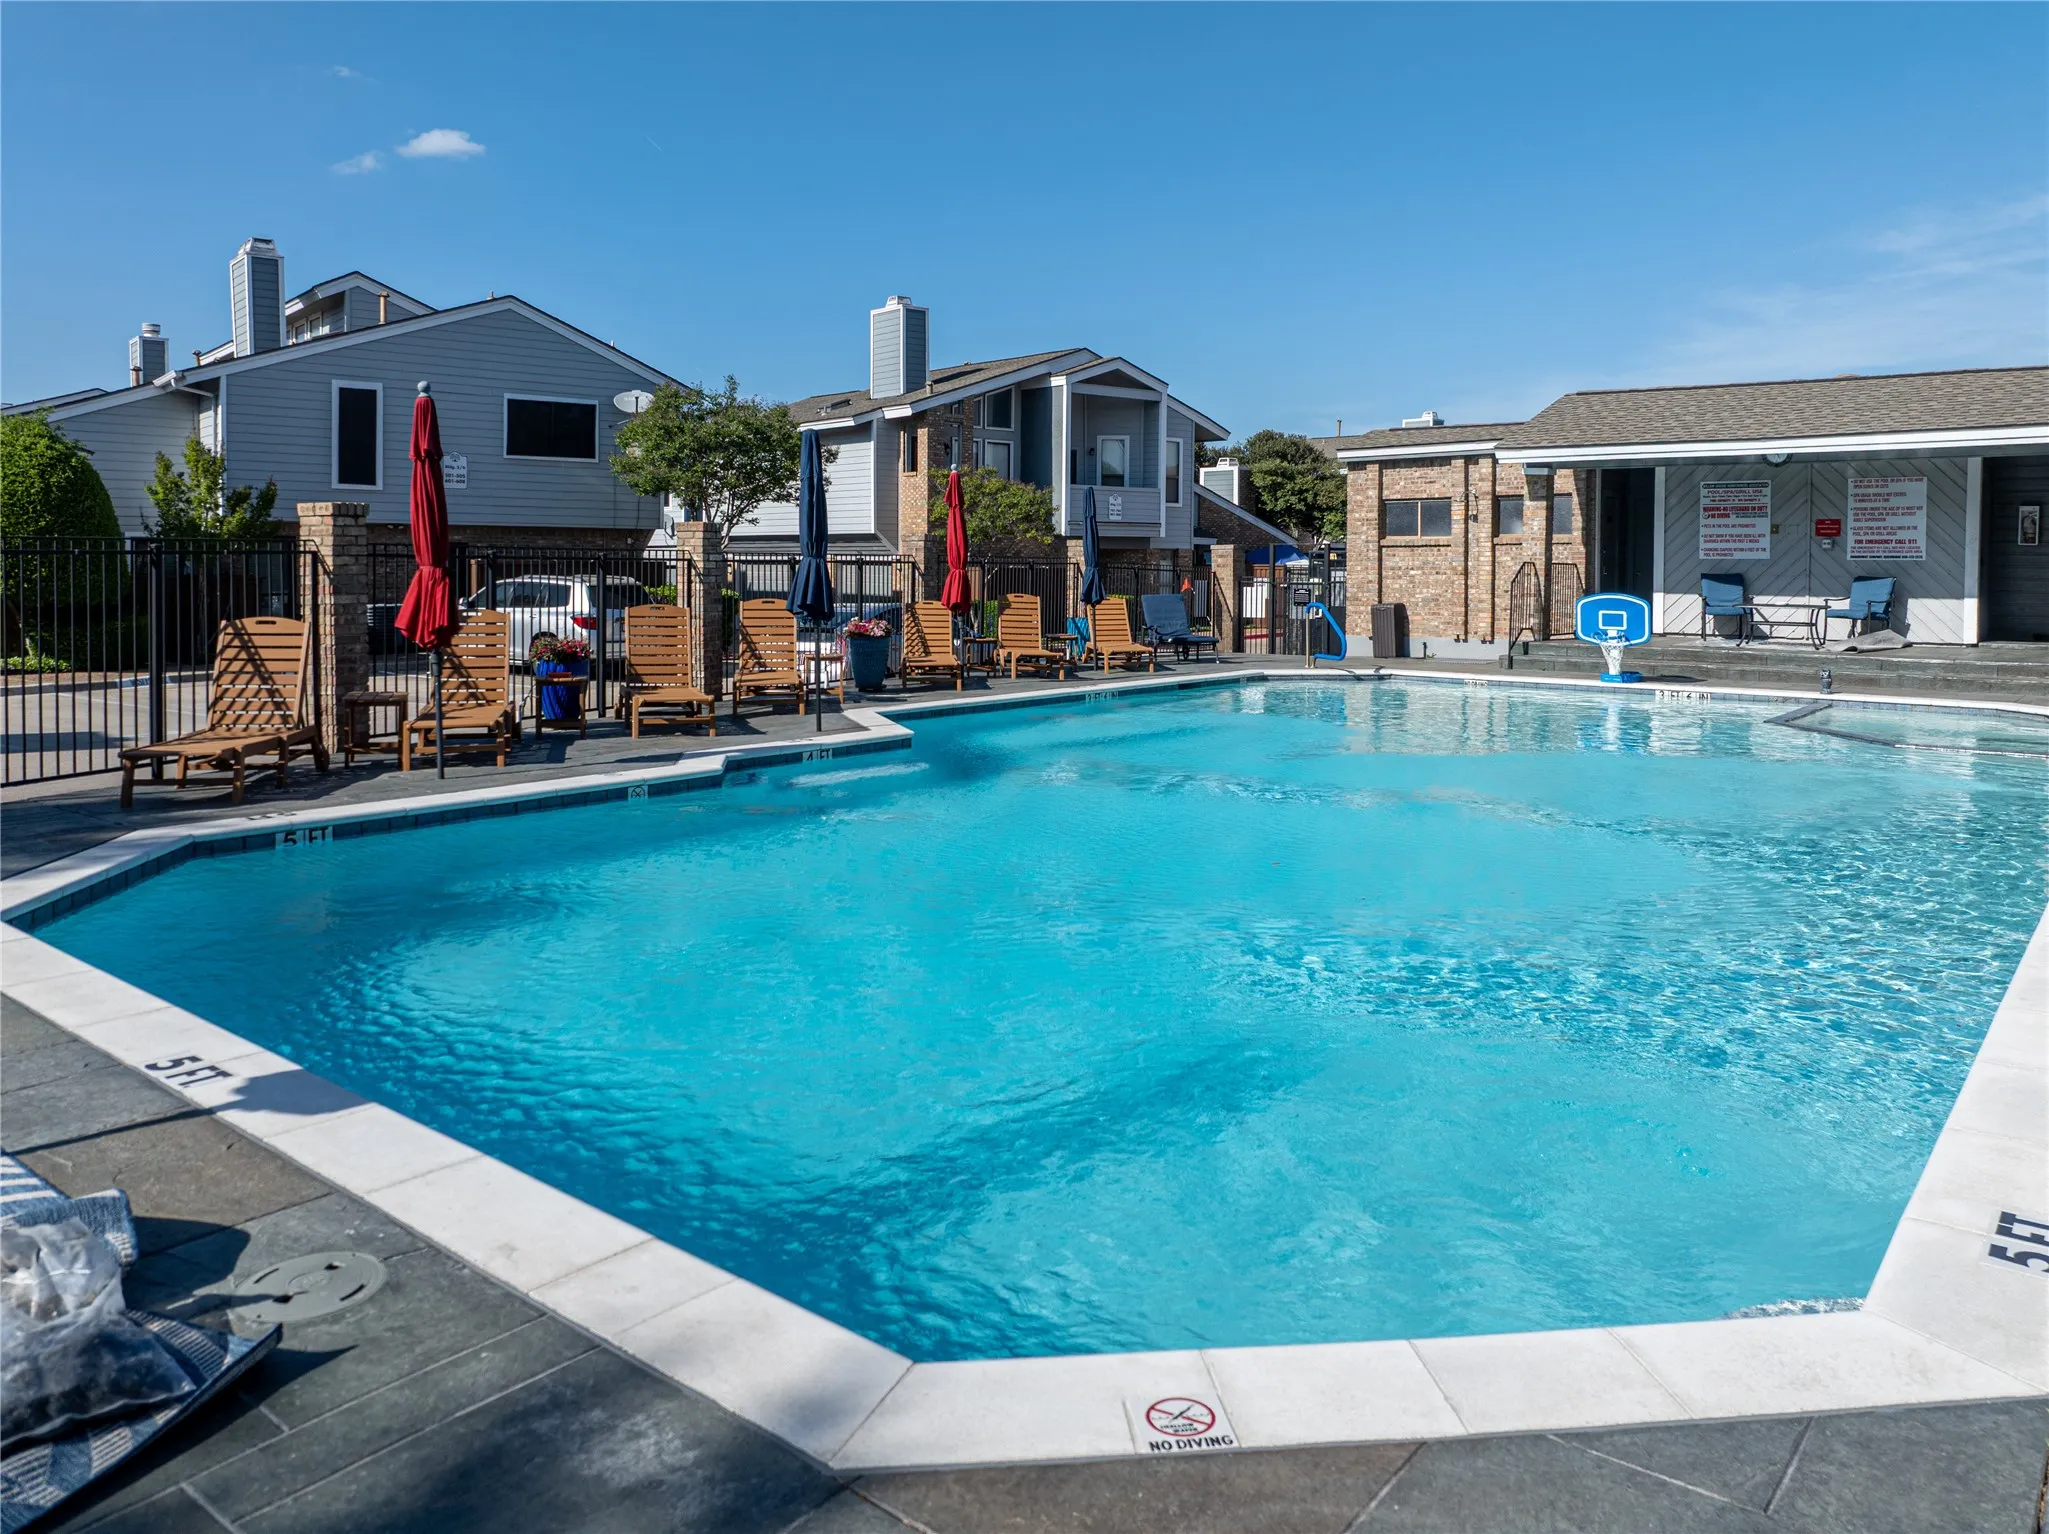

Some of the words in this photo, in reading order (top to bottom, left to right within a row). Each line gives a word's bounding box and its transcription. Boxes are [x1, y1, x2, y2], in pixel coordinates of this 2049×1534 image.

[284, 831, 297, 846] 5
[309, 826, 329, 843] FT
[144, 1056, 204, 1071] 5
[164, 1064, 233, 1086] FT
[1996, 1211, 2049, 1247] FT
[1988, 1244, 2049, 1273] 5
[1148, 1440, 1172, 1452] NO
[1176, 1435, 1234, 1450] DIVING
